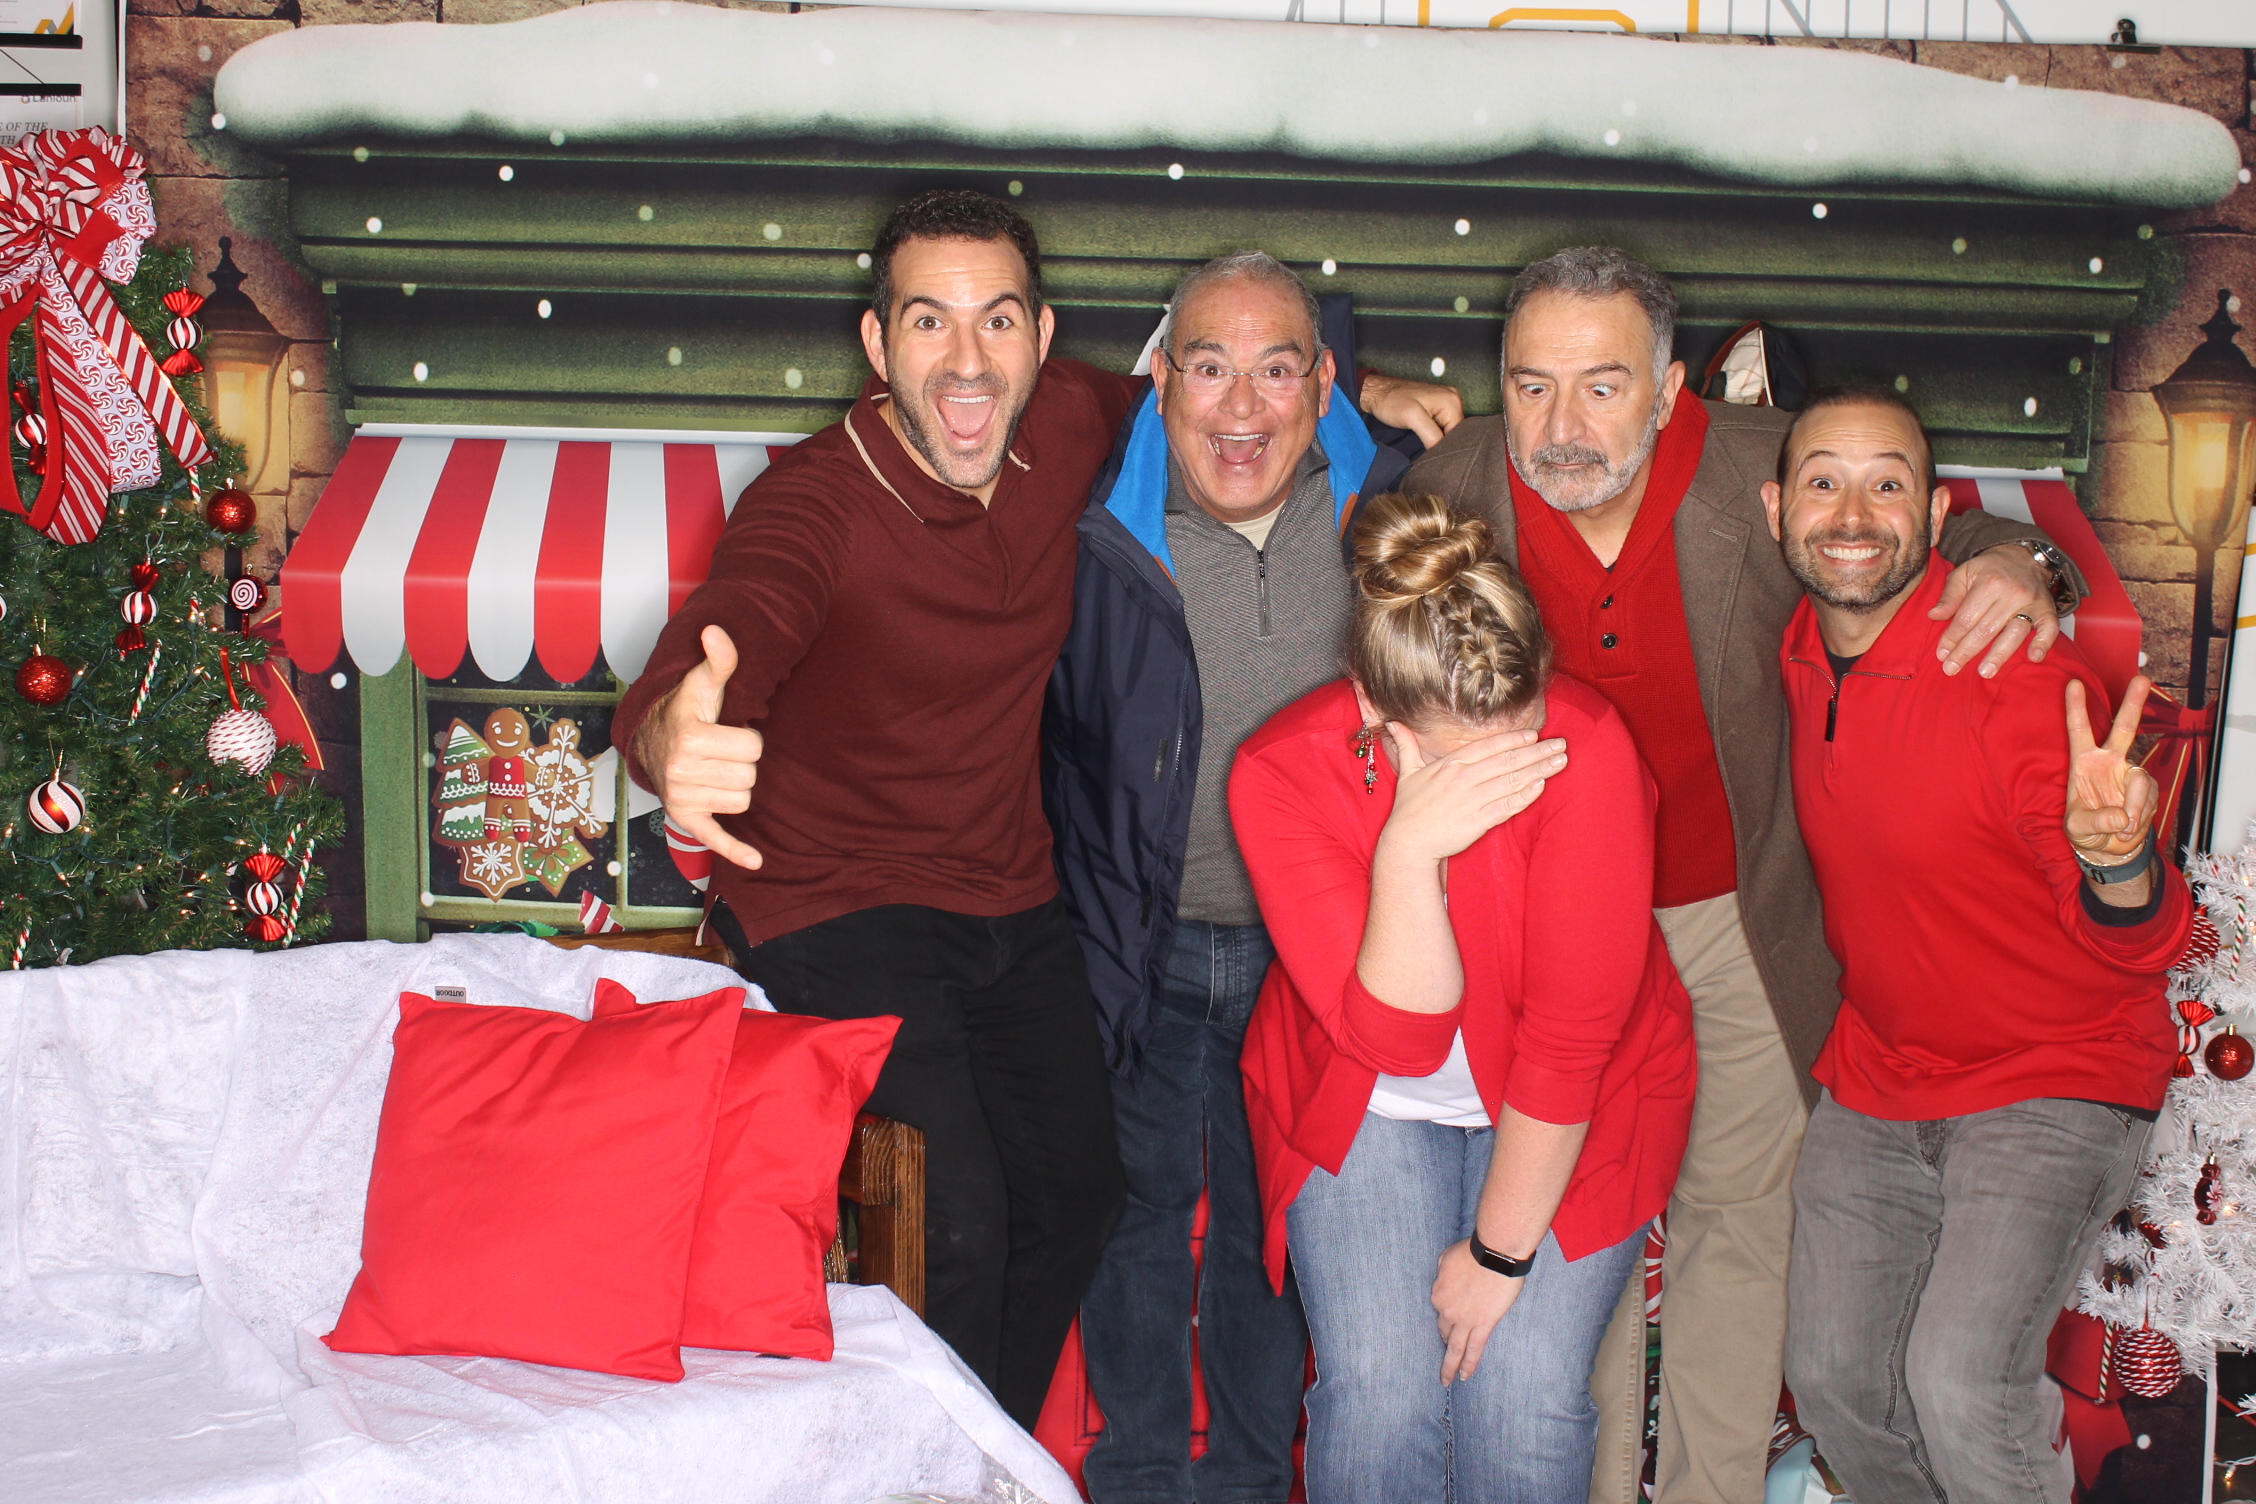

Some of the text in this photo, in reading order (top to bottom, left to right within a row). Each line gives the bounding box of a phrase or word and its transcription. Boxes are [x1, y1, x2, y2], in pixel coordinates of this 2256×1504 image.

[6, 122, 22, 131] OF
[25, 122, 48, 131] THE
[435, 989, 465, 997] OUTDOOR
